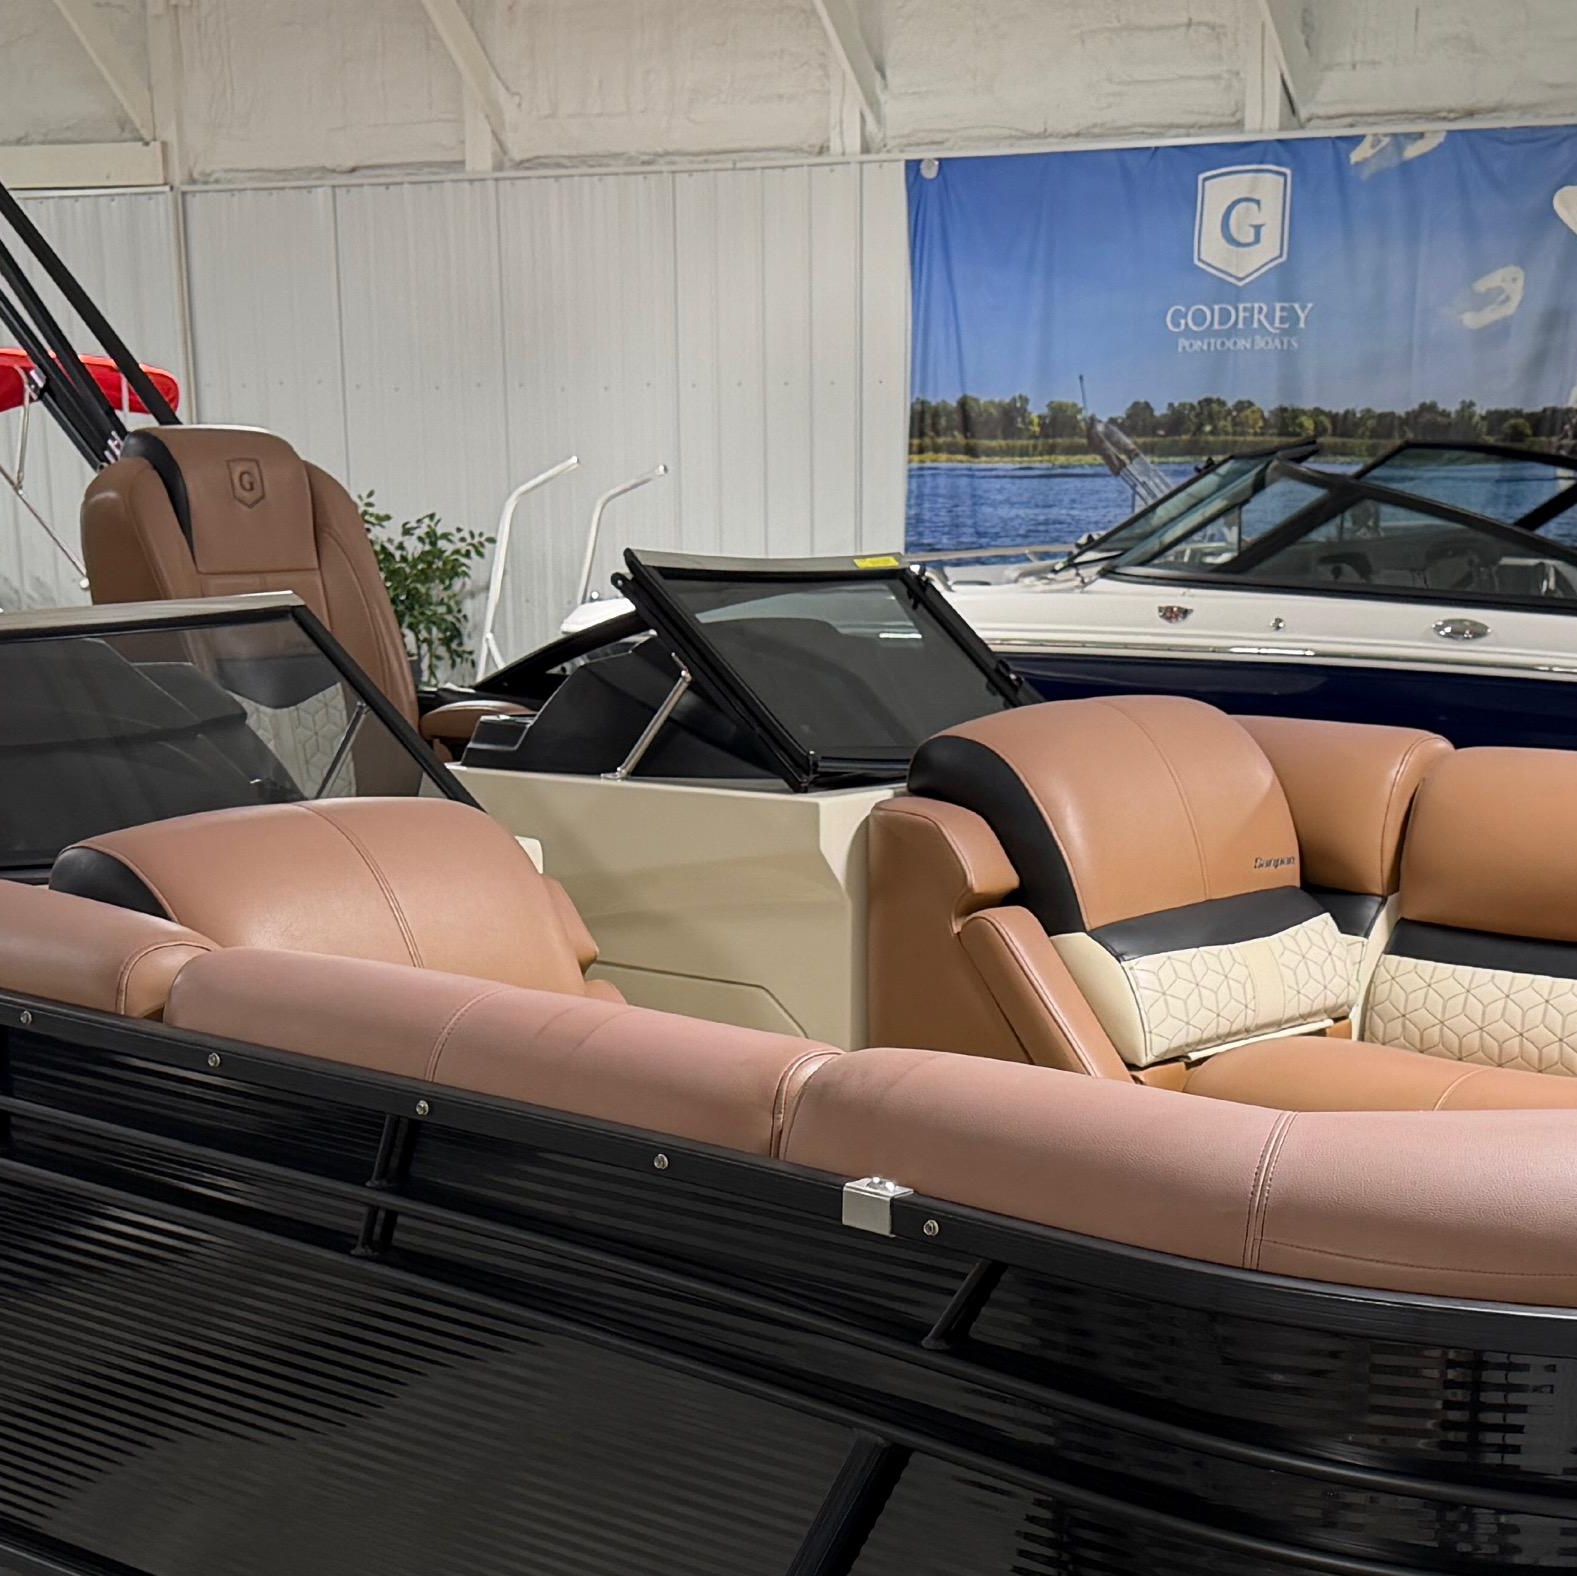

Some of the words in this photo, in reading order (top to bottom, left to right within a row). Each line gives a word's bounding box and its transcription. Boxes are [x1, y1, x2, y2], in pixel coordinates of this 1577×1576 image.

[1220, 196, 1266, 248] G
[1166, 303, 1315, 333] GODFREY
[239, 471, 254, 492] G
